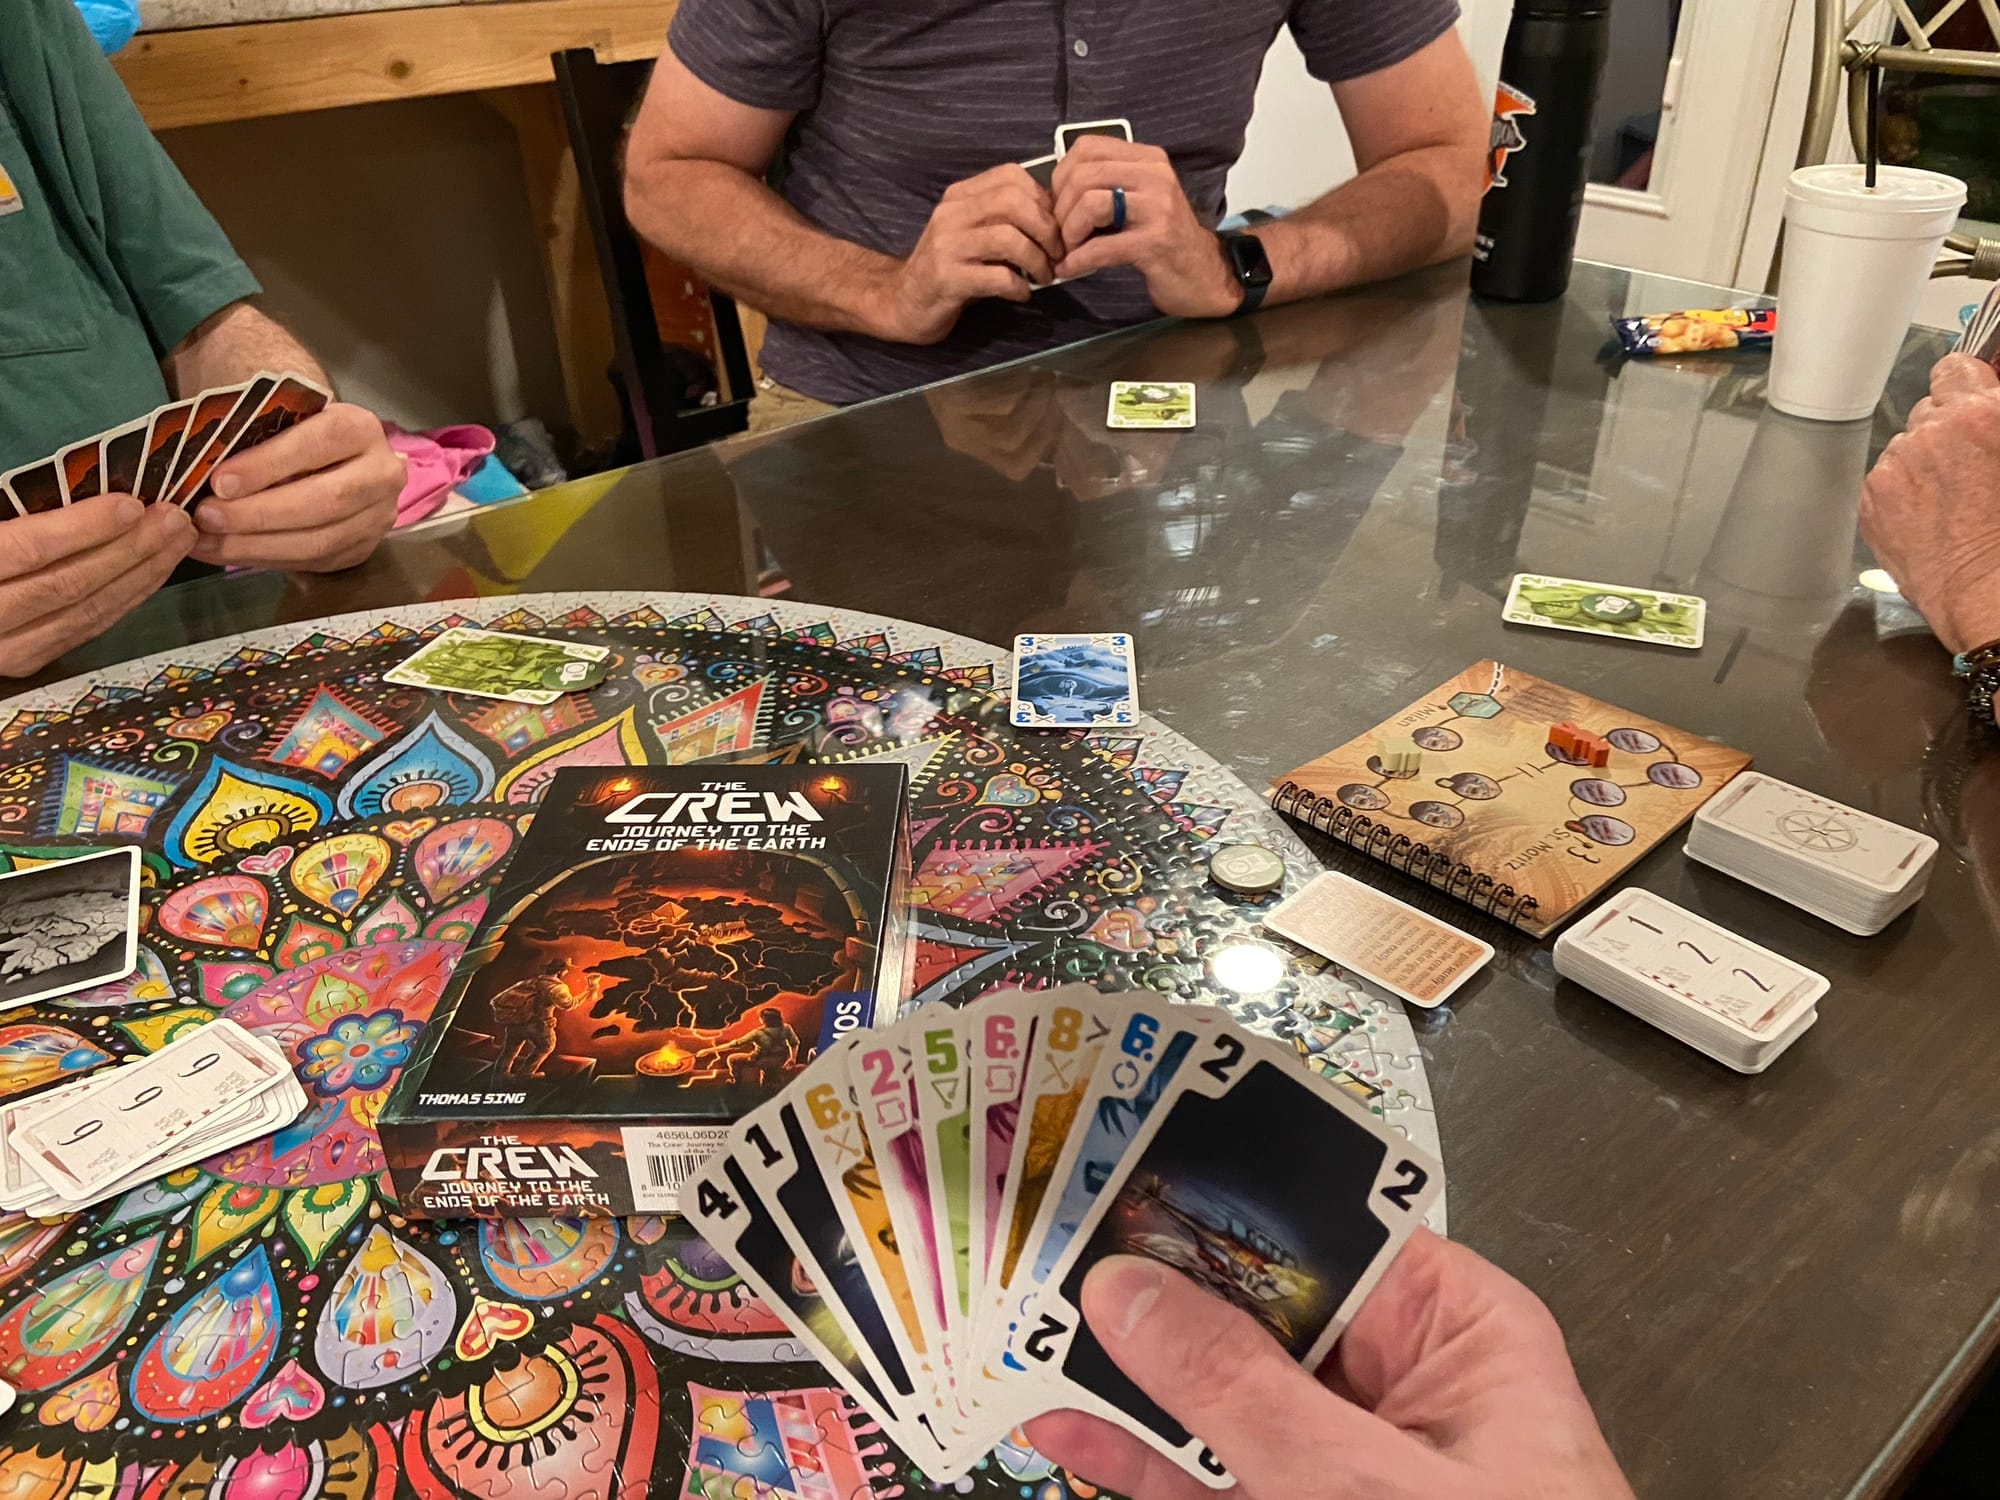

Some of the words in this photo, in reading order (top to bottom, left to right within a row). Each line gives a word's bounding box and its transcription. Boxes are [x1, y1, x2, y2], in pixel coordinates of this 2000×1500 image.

[1020, 637, 1034, 646] 3
[1112, 636, 1126, 646] 3
[1016, 712, 1031, 723] 3
[1117, 712, 1131, 723] 3
[1398, 707, 1437, 727] Milan
[701, 781, 747, 792] THE
[604, 792, 824, 824] CREW
[612, 825, 723, 838] JOURNEY
[729, 825, 759, 837] TO
[763, 824, 811, 836] THE
[586, 839, 649, 851] ENDS
[655, 838, 688, 850] OF
[692, 838, 739, 850] THE
[746, 837, 827, 850] EARTH
[1504, 841, 1554, 870] Moritz
[1567, 847, 1601, 864] 3
[1627, 916, 1663, 935] 1
[1677, 941, 1720, 965] 2
[1732, 968, 1776, 993] 2
[832, 1001, 862, 1040] OS
[1048, 1006, 1083, 1052] 8
[924, 1029, 959, 1074] 5
[1200, 1033, 1245, 1084] 2
[862, 1049, 901, 1097] 2
[418, 1093, 481, 1105] THOMAS
[483, 1092, 527, 1104] SING
[480, 1135, 522, 1146] THE
[745, 1123, 784, 1168] 1
[421, 1146, 600, 1181] CREW
[438, 1181, 521, 1195] JOURNEY
[527, 1181, 551, 1193] TO
[556, 1180, 593, 1192] THE
[1380, 1159, 1428, 1212] 2
[423, 1196, 473, 1209] ENDS
[478, 1195, 499, 1207] OF
[506, 1194, 543, 1206] THE
[548, 1193, 610, 1206] EARTH
[697, 1178, 739, 1219] 4
[1025, 1313, 1069, 1362] 2
